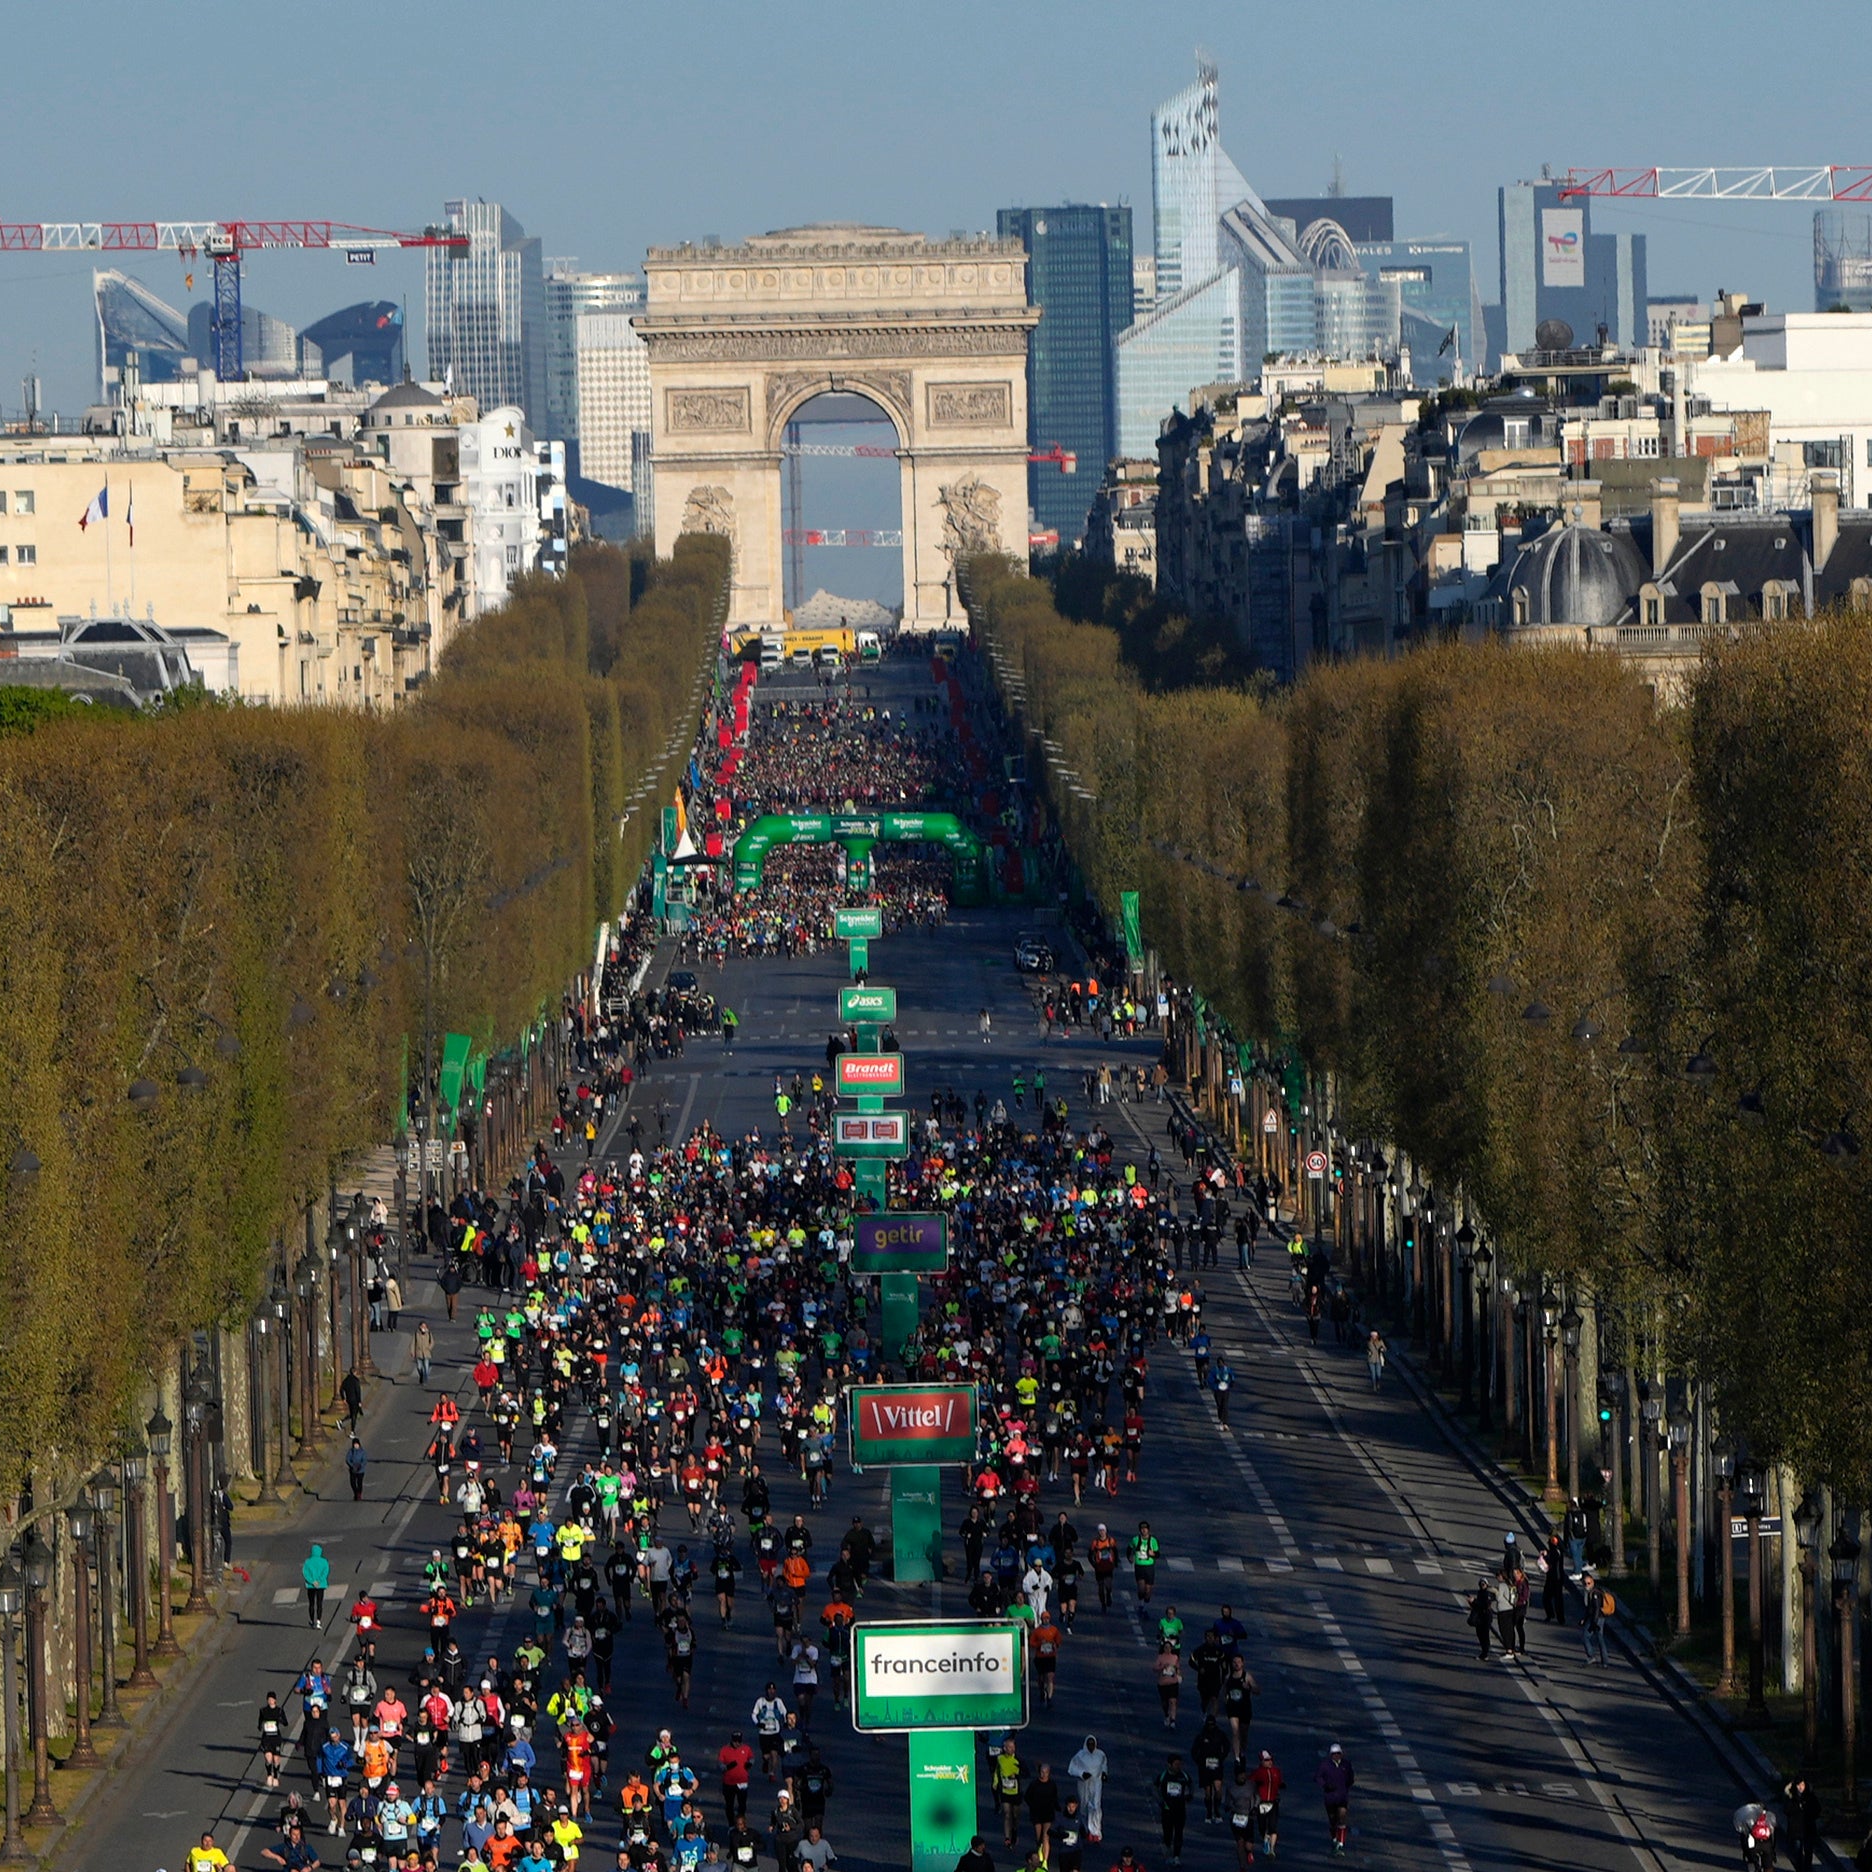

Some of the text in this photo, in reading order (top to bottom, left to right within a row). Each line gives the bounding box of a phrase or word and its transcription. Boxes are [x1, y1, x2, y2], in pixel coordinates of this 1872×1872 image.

[350, 253, 371, 262] PETIT
[494, 447, 522, 459] DIOR
[859, 997, 883, 1006] asics
[845, 1063, 894, 1073] Brandt
[874, 1225, 924, 1249] getir
[883, 1405, 942, 1429] Vittel
[871, 1652, 1008, 1675] franceinfo:
